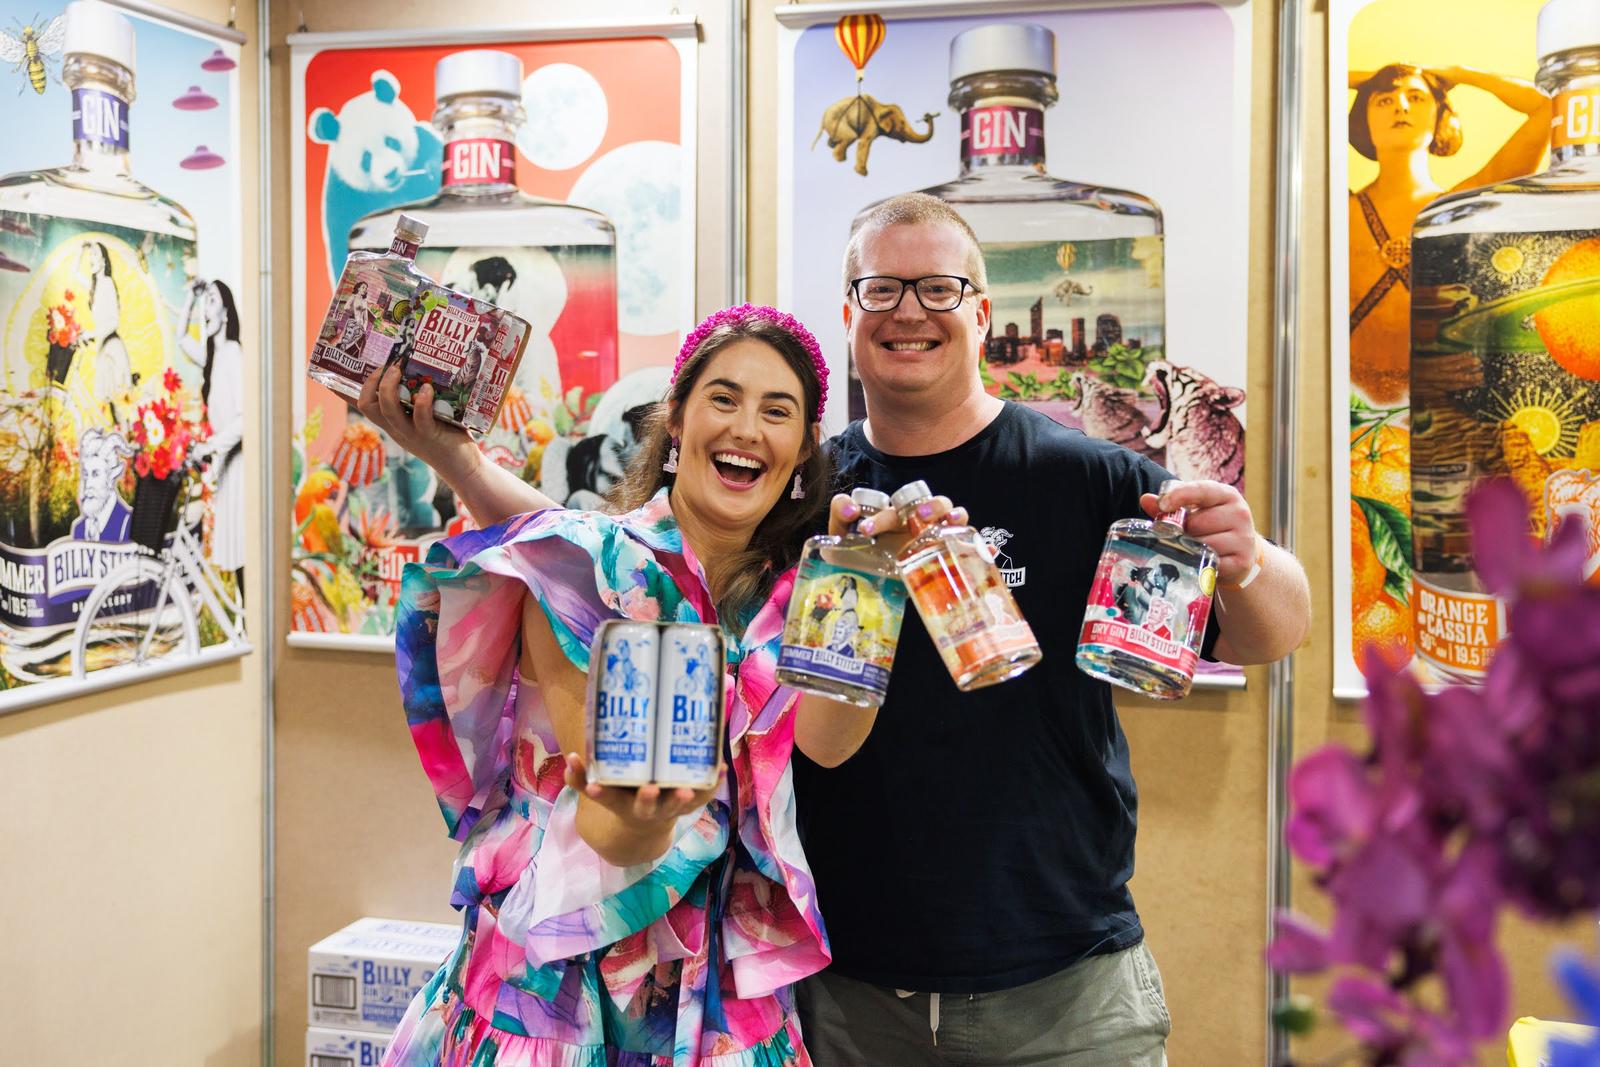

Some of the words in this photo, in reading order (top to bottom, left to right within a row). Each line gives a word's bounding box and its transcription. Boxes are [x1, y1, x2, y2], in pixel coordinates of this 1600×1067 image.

[82, 94, 120, 141] GIN
[973, 110, 1027, 149] GIN
[453, 142, 502, 180] GIN
[391, 239, 408, 255] GIN
[424, 309, 475, 343] BILLY
[419, 329, 438, 346] GIN
[447, 340, 465, 356] TIN
[324, 347, 342, 362] BILLY
[340, 354, 364, 372] STITCH
[54, 549, 96, 585] BILLY
[1421, 589, 1489, 625] ORANGE
[1092, 623, 1110, 635] DRY
[1109, 624, 1127, 641] GIN
[1129, 628, 1151, 644] BILLY
[1150, 637, 1179, 656] STITCH
[1427, 612, 1489, 647] CASSIA
[597, 691, 649, 719] BILLY
[363, 960, 411, 987] BILLY
